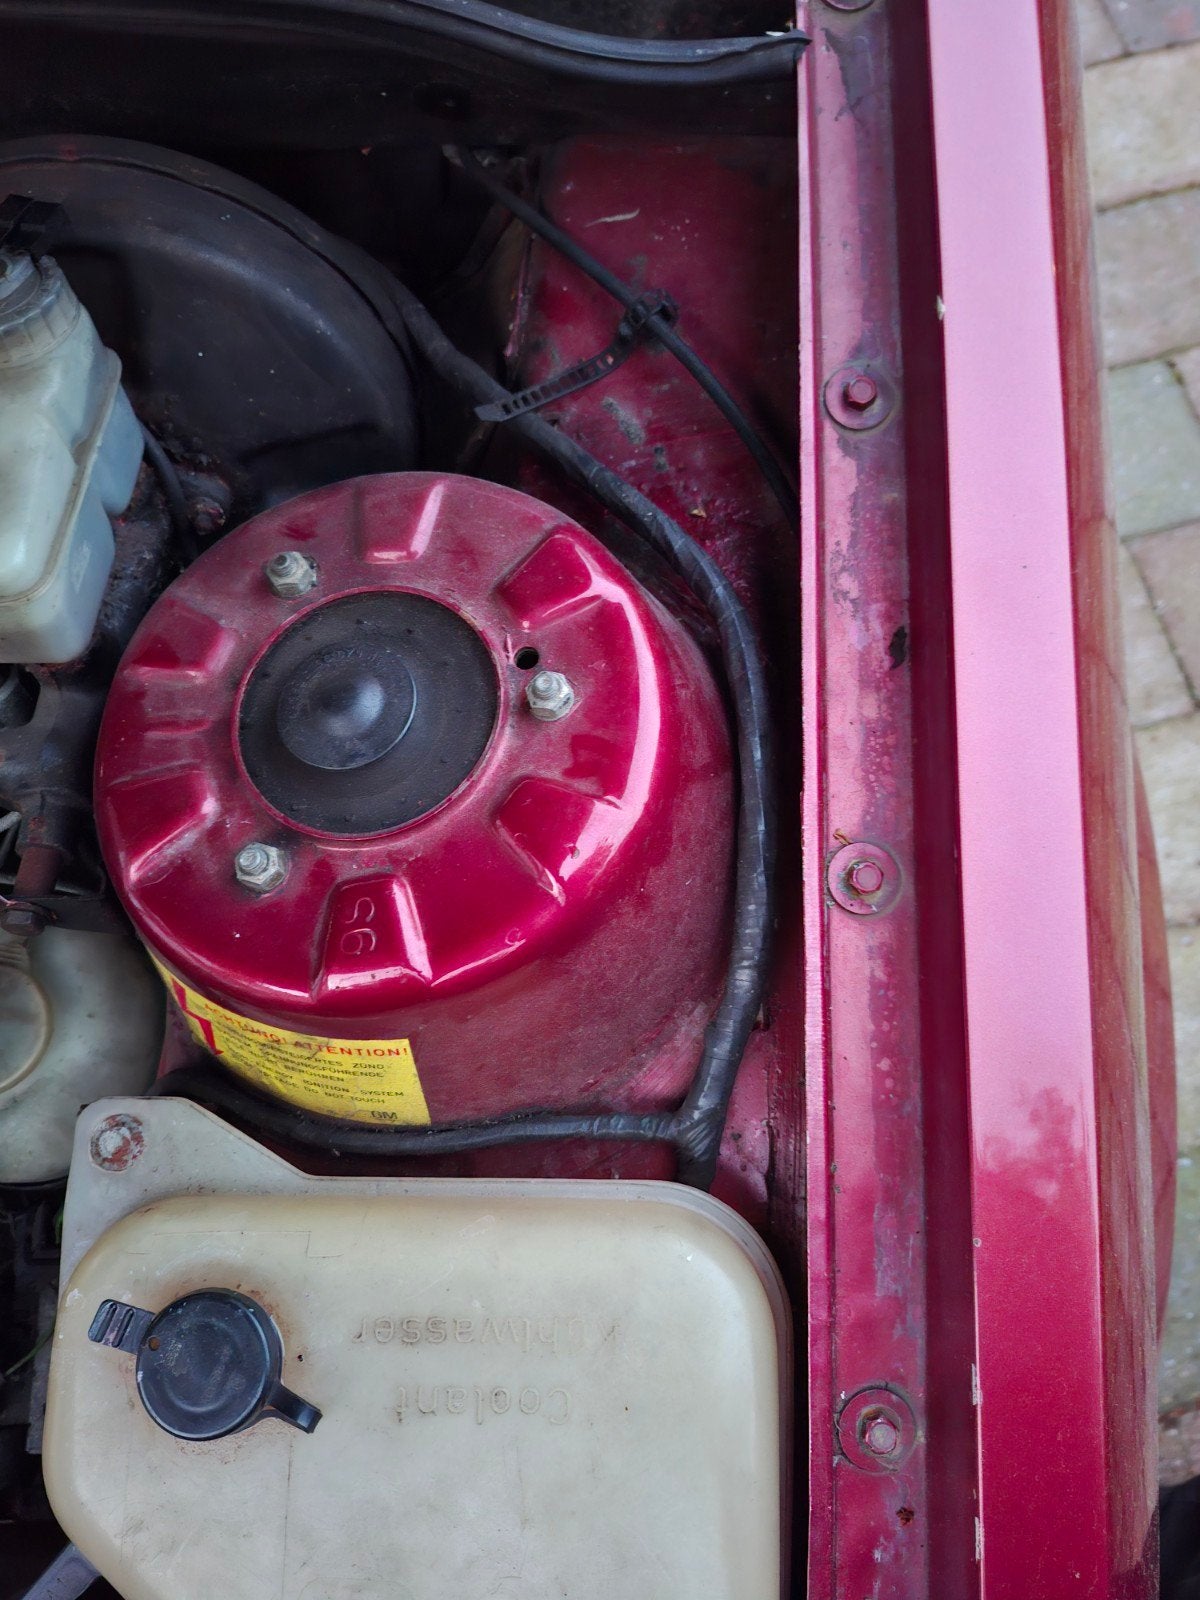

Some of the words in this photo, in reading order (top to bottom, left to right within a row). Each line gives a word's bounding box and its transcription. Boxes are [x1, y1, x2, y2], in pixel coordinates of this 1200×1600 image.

[293, 1040, 408, 1057] ATTENTION!
[303, 1079, 350, 1094] IGNITION
[361, 1089, 404, 1098] SYSTEM
[324, 1091, 345, 1099] NOT
[350, 1095, 385, 1104] TOUCH
[371, 1110, 398, 1120] GM
[393, 1384, 572, 1427] Coolant
